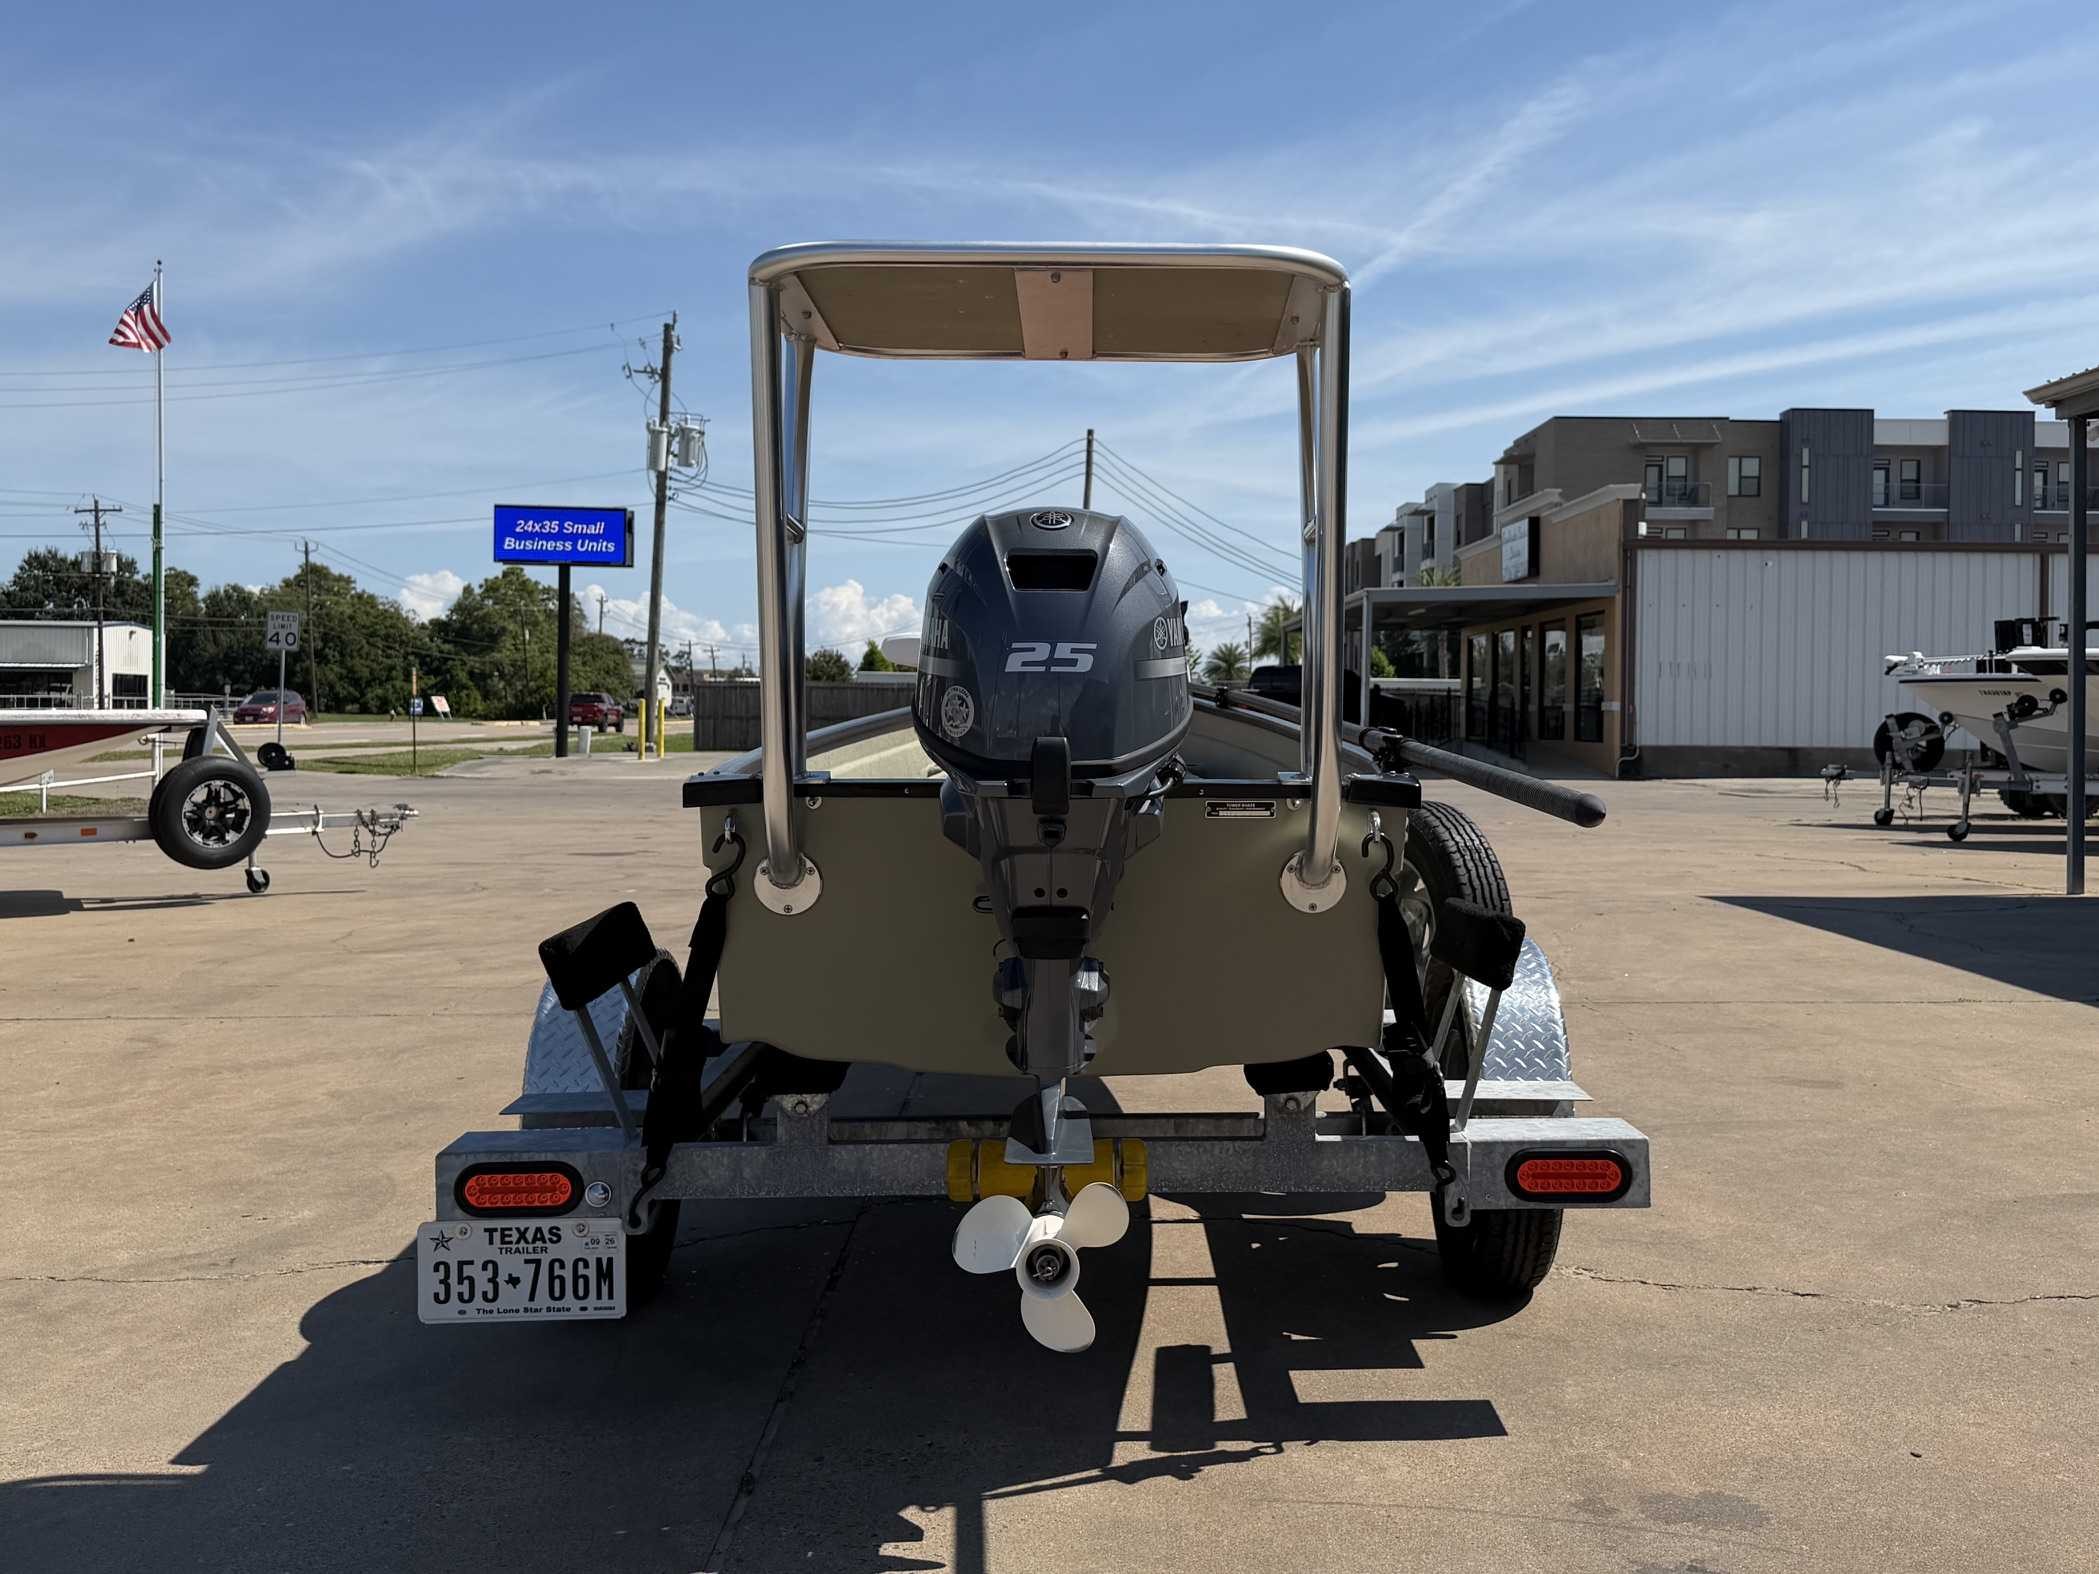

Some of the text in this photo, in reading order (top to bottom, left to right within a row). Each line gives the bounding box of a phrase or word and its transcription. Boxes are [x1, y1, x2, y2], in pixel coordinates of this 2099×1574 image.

[515, 519, 605, 534] 24x35 Small
[503, 536, 616, 552] Business Units
[270, 613, 298, 622] SPEED
[268, 631, 297, 646] 40
[1004, 642, 1098, 673] 25
[483, 1226, 562, 1245] TEXAS
[497, 1246, 549, 1255] TRAILER
[432, 1256, 615, 1305] 353 766M
[475, 1307, 495, 1315] The
[523, 1306, 544, 1314] Star
[545, 1305, 572, 1313] State
